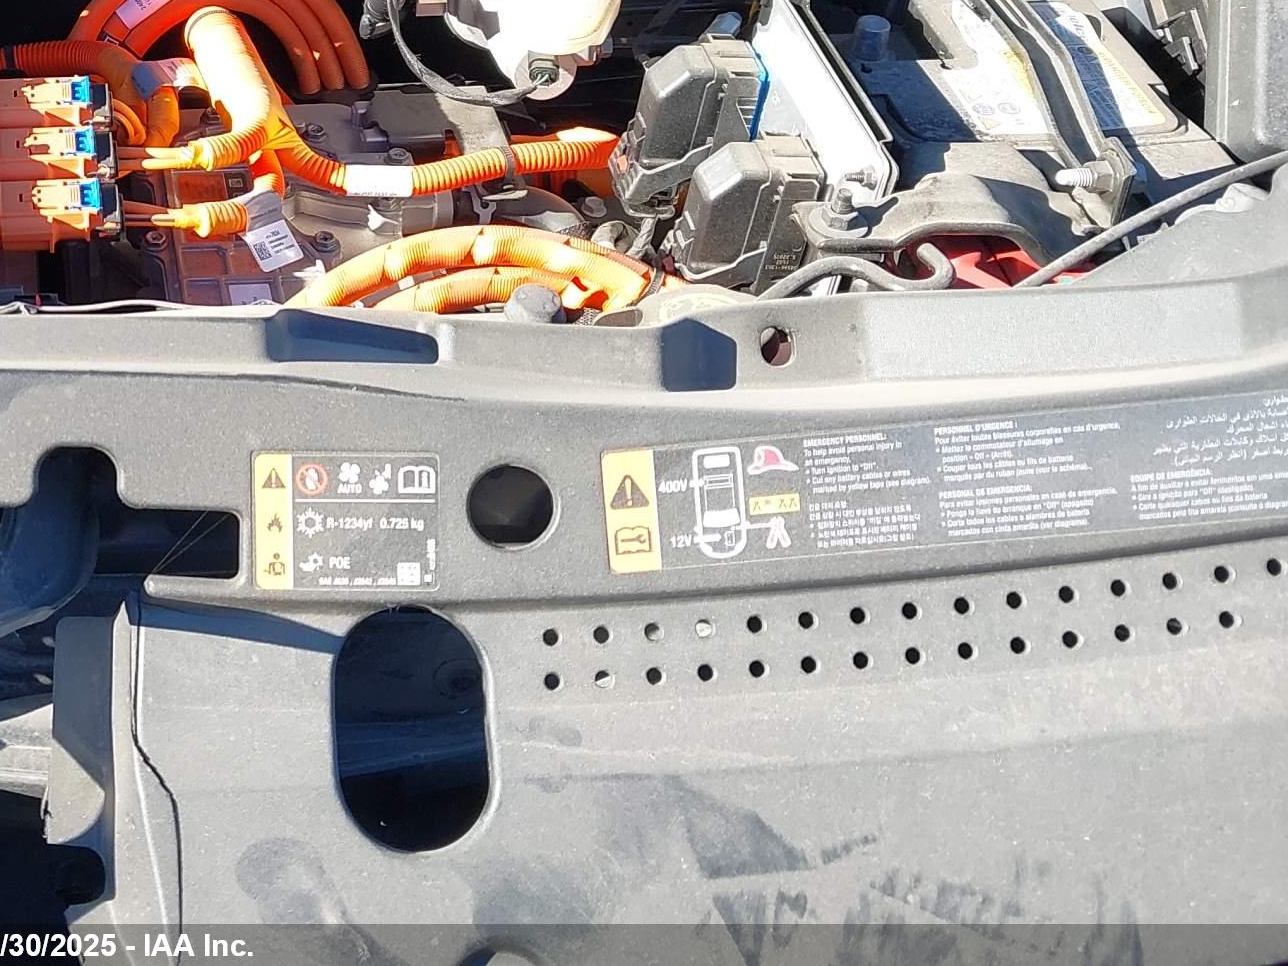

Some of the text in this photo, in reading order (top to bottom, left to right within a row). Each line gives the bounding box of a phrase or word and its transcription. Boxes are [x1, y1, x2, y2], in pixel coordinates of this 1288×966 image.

[934, 425, 973, 436] PERSONNEL
[803, 436, 844, 448] EMERGENCY
[935, 436, 950, 445] Pour
[973, 440, 1016, 451] commutateur
[813, 448, 826, 457] help
[828, 446, 846, 454] avoid
[847, 444, 874, 454] personal
[876, 442, 894, 452] injury
[942, 454, 968, 465] position
[827, 464, 850, 474] ignition
[943, 464, 966, 473] Couper
[838, 472, 860, 482] battery
[1130, 472, 1154, 483] EQUIPE
[1156, 472, 1165, 480] DE
[337, 484, 362, 494] AUTO
[658, 478, 688, 494] 400V
[813, 484, 837, 494] marked
[848, 481, 868, 492] yellow
[938, 489, 974, 500] PERSONAL
[976, 488, 986, 496] DE
[1004, 494, 1040, 504] personales
[946, 510, 967, 518] Ponga
[326, 517, 424, 532] R-1234yf 0.725 kg
[948, 528, 980, 536] marcados
[670, 534, 694, 548] 12V
[329, 556, 351, 569] POE
